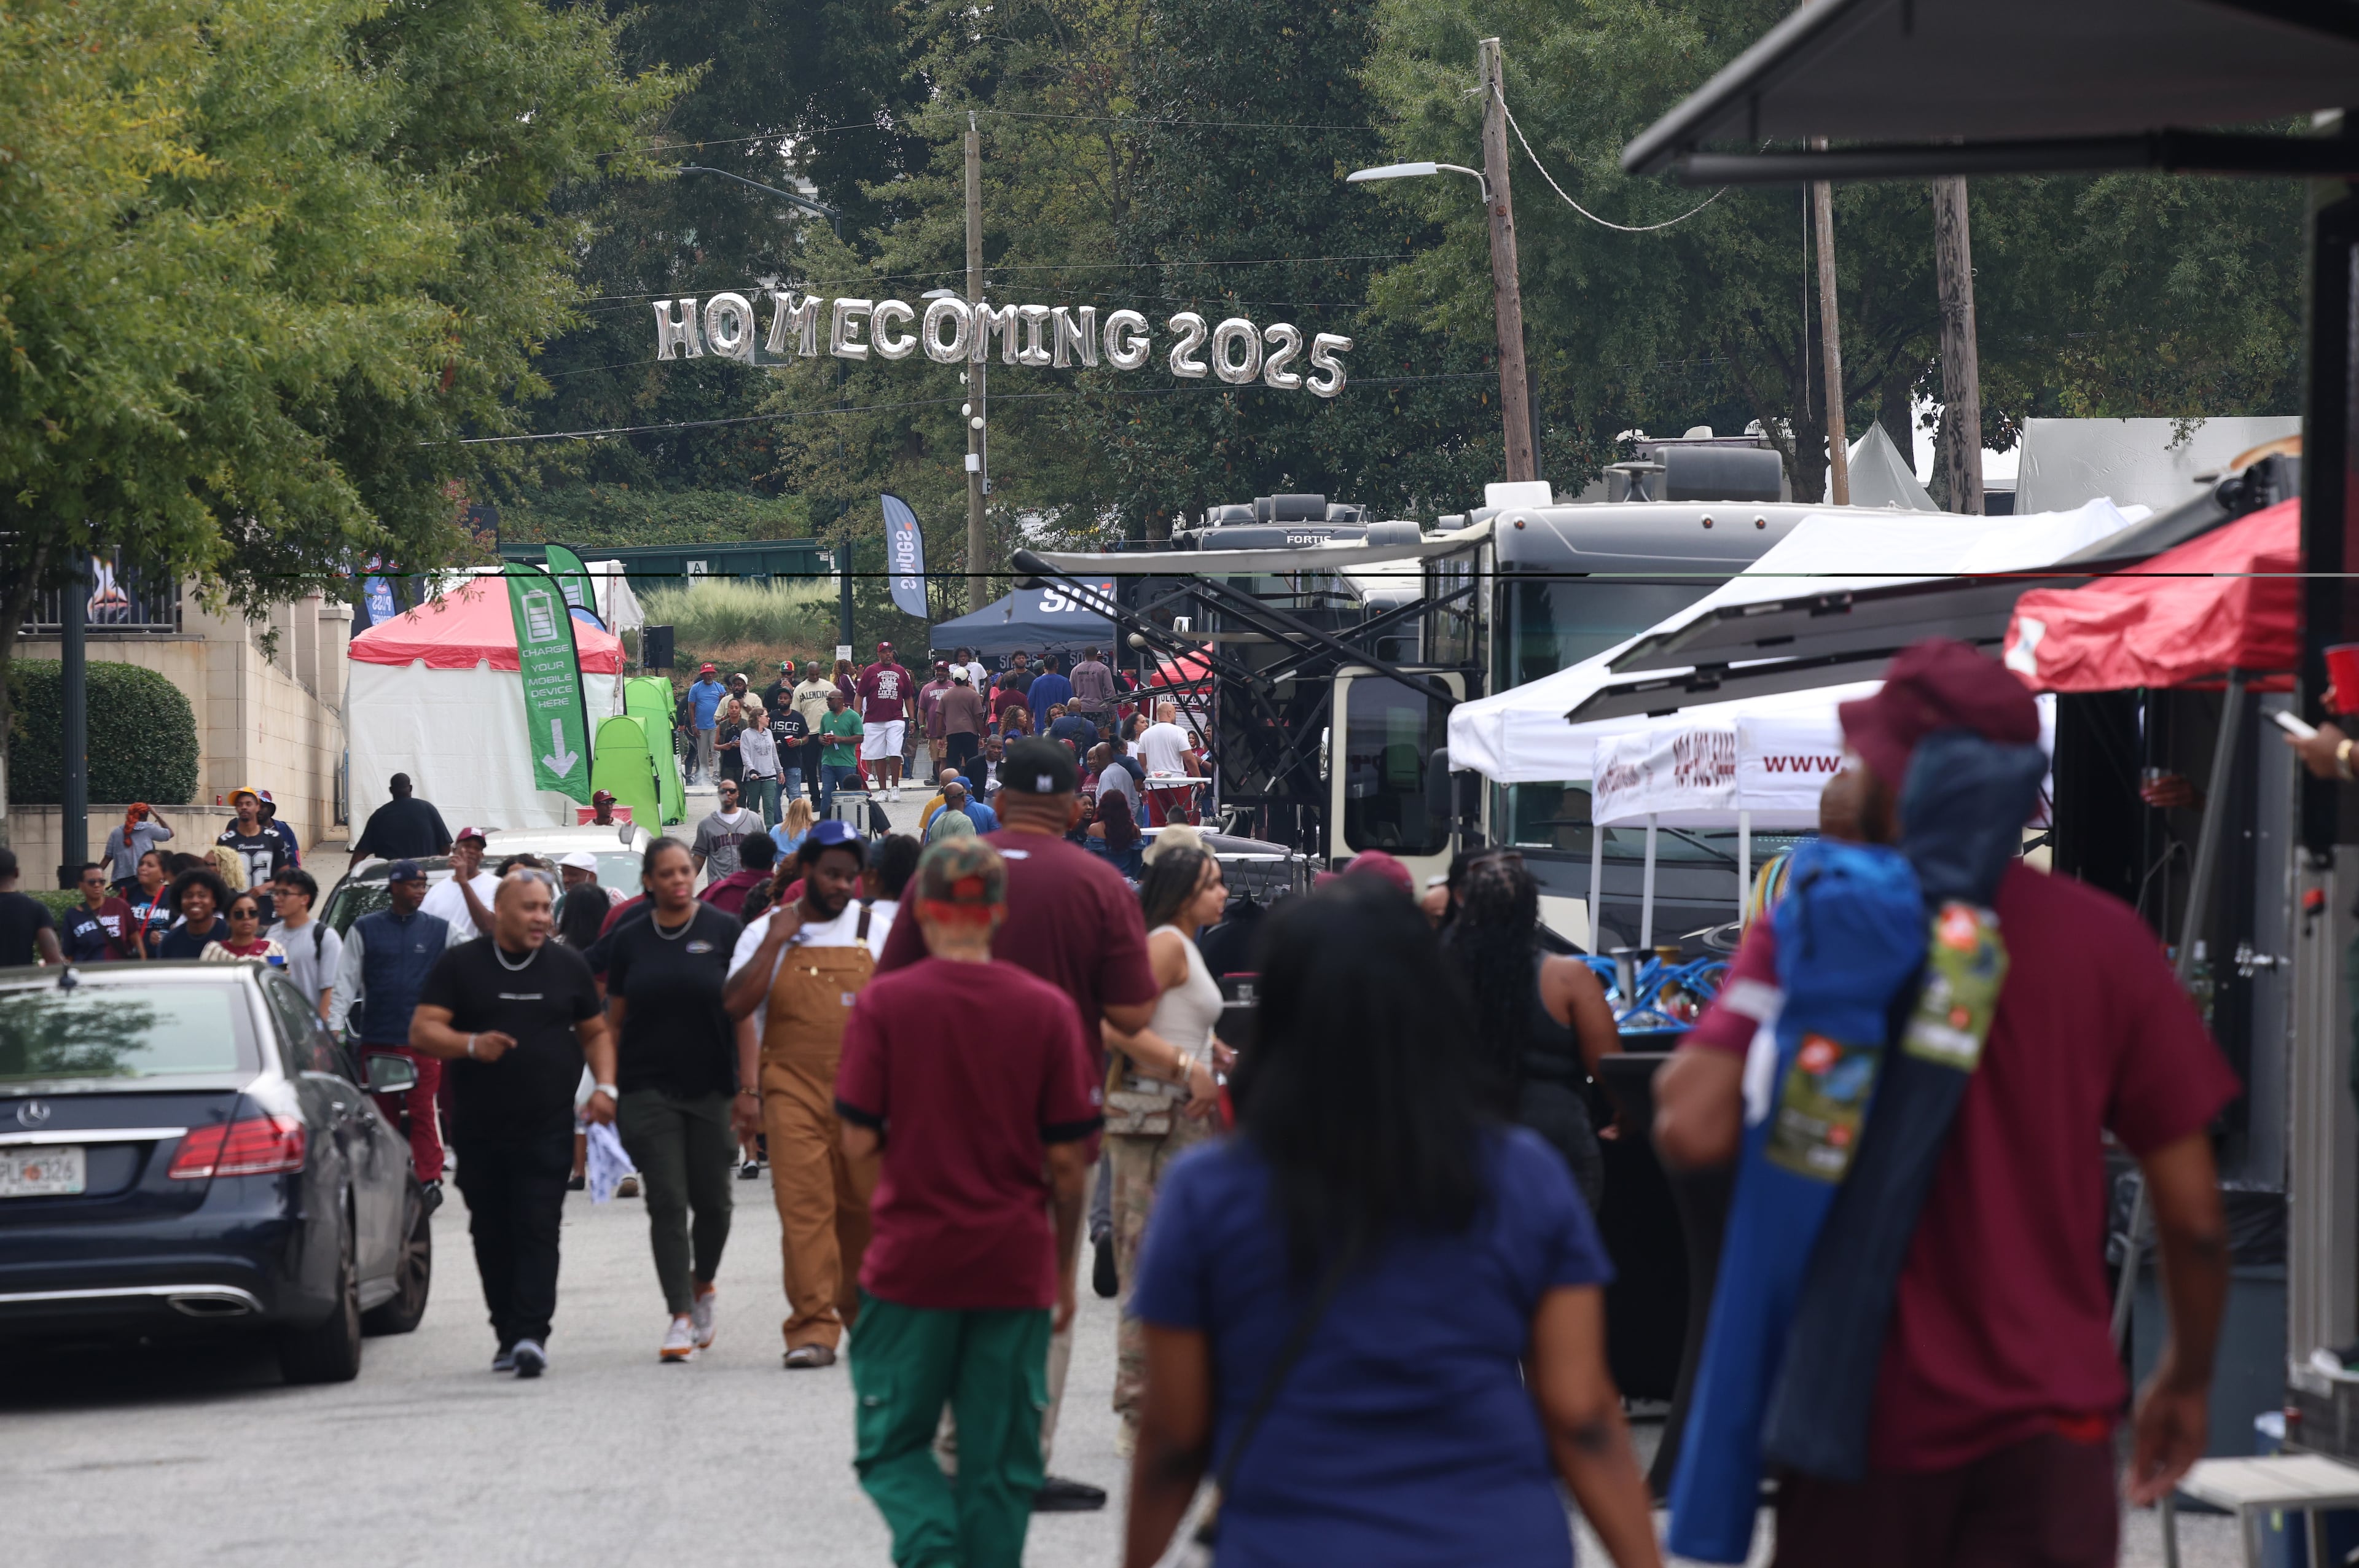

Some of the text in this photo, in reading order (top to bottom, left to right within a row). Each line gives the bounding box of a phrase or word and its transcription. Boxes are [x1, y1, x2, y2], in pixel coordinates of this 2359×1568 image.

[653, 292, 1353, 397] HOMECOMING 2025
[1287, 535, 1331, 544] FORTIS
[1039, 583, 1113, 616] sni
[522, 644, 569, 658] CHARGE
[531, 661, 565, 672] YOUR
[528, 673, 573, 686] MOBILE
[531, 685, 573, 698] DEVICE
[538, 698, 569, 708] HERE
[770, 721, 800, 731] USCG
